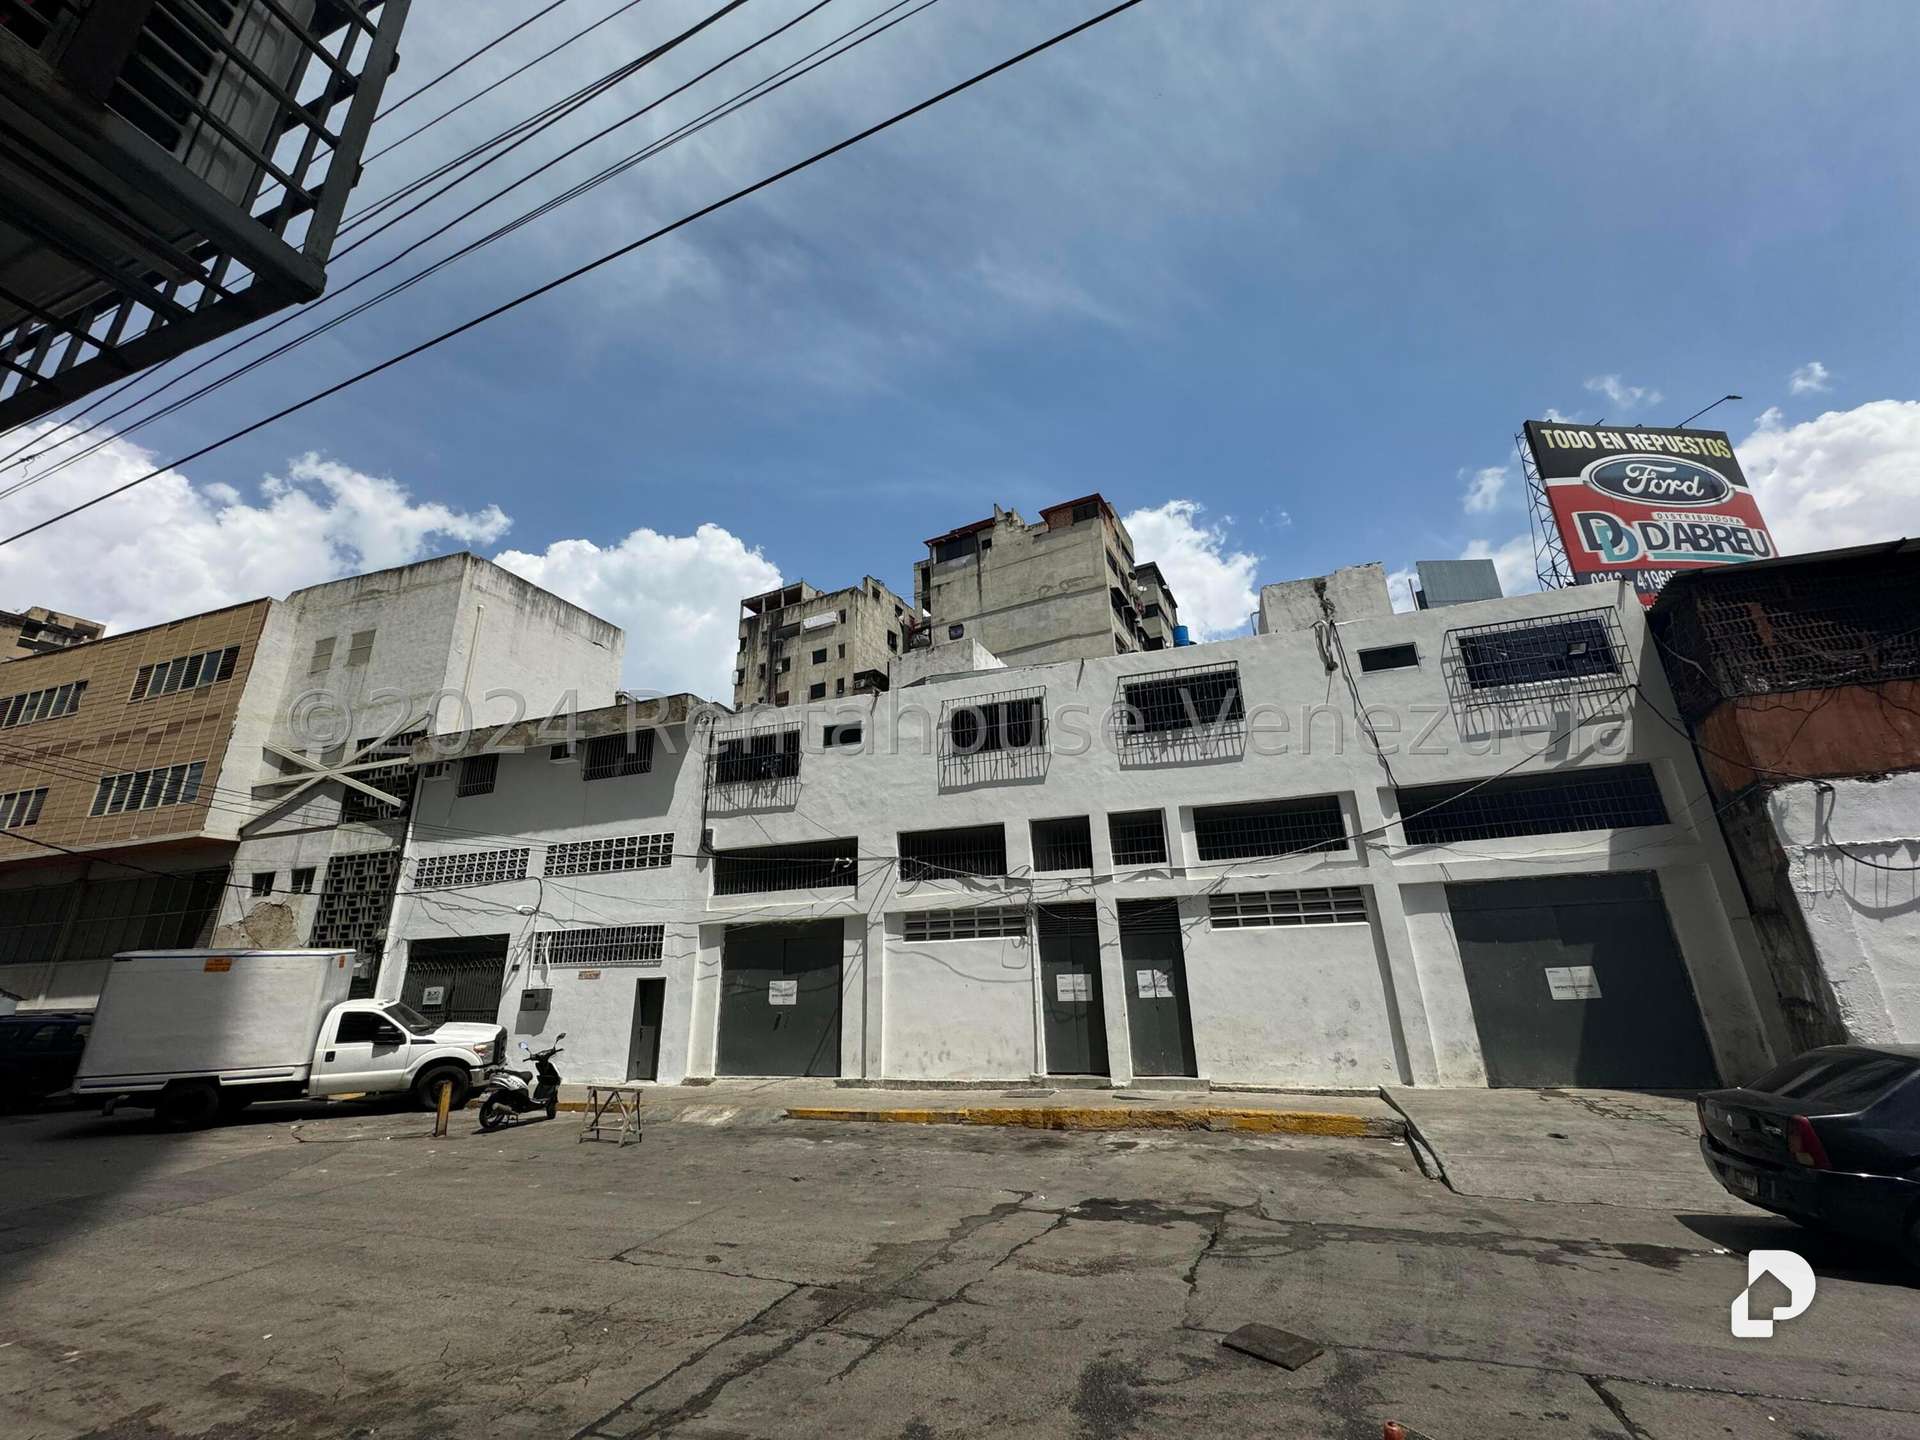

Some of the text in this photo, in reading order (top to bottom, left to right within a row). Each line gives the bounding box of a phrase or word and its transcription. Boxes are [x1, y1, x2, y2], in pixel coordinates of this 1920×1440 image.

[1541, 429, 1731, 459] TODO EN REPUESTOS
[1622, 463, 1705, 498] Ford
[1657, 512, 1742, 524] DISTRIBUIDORA
[1640, 522, 1770, 558] D'ABREU
